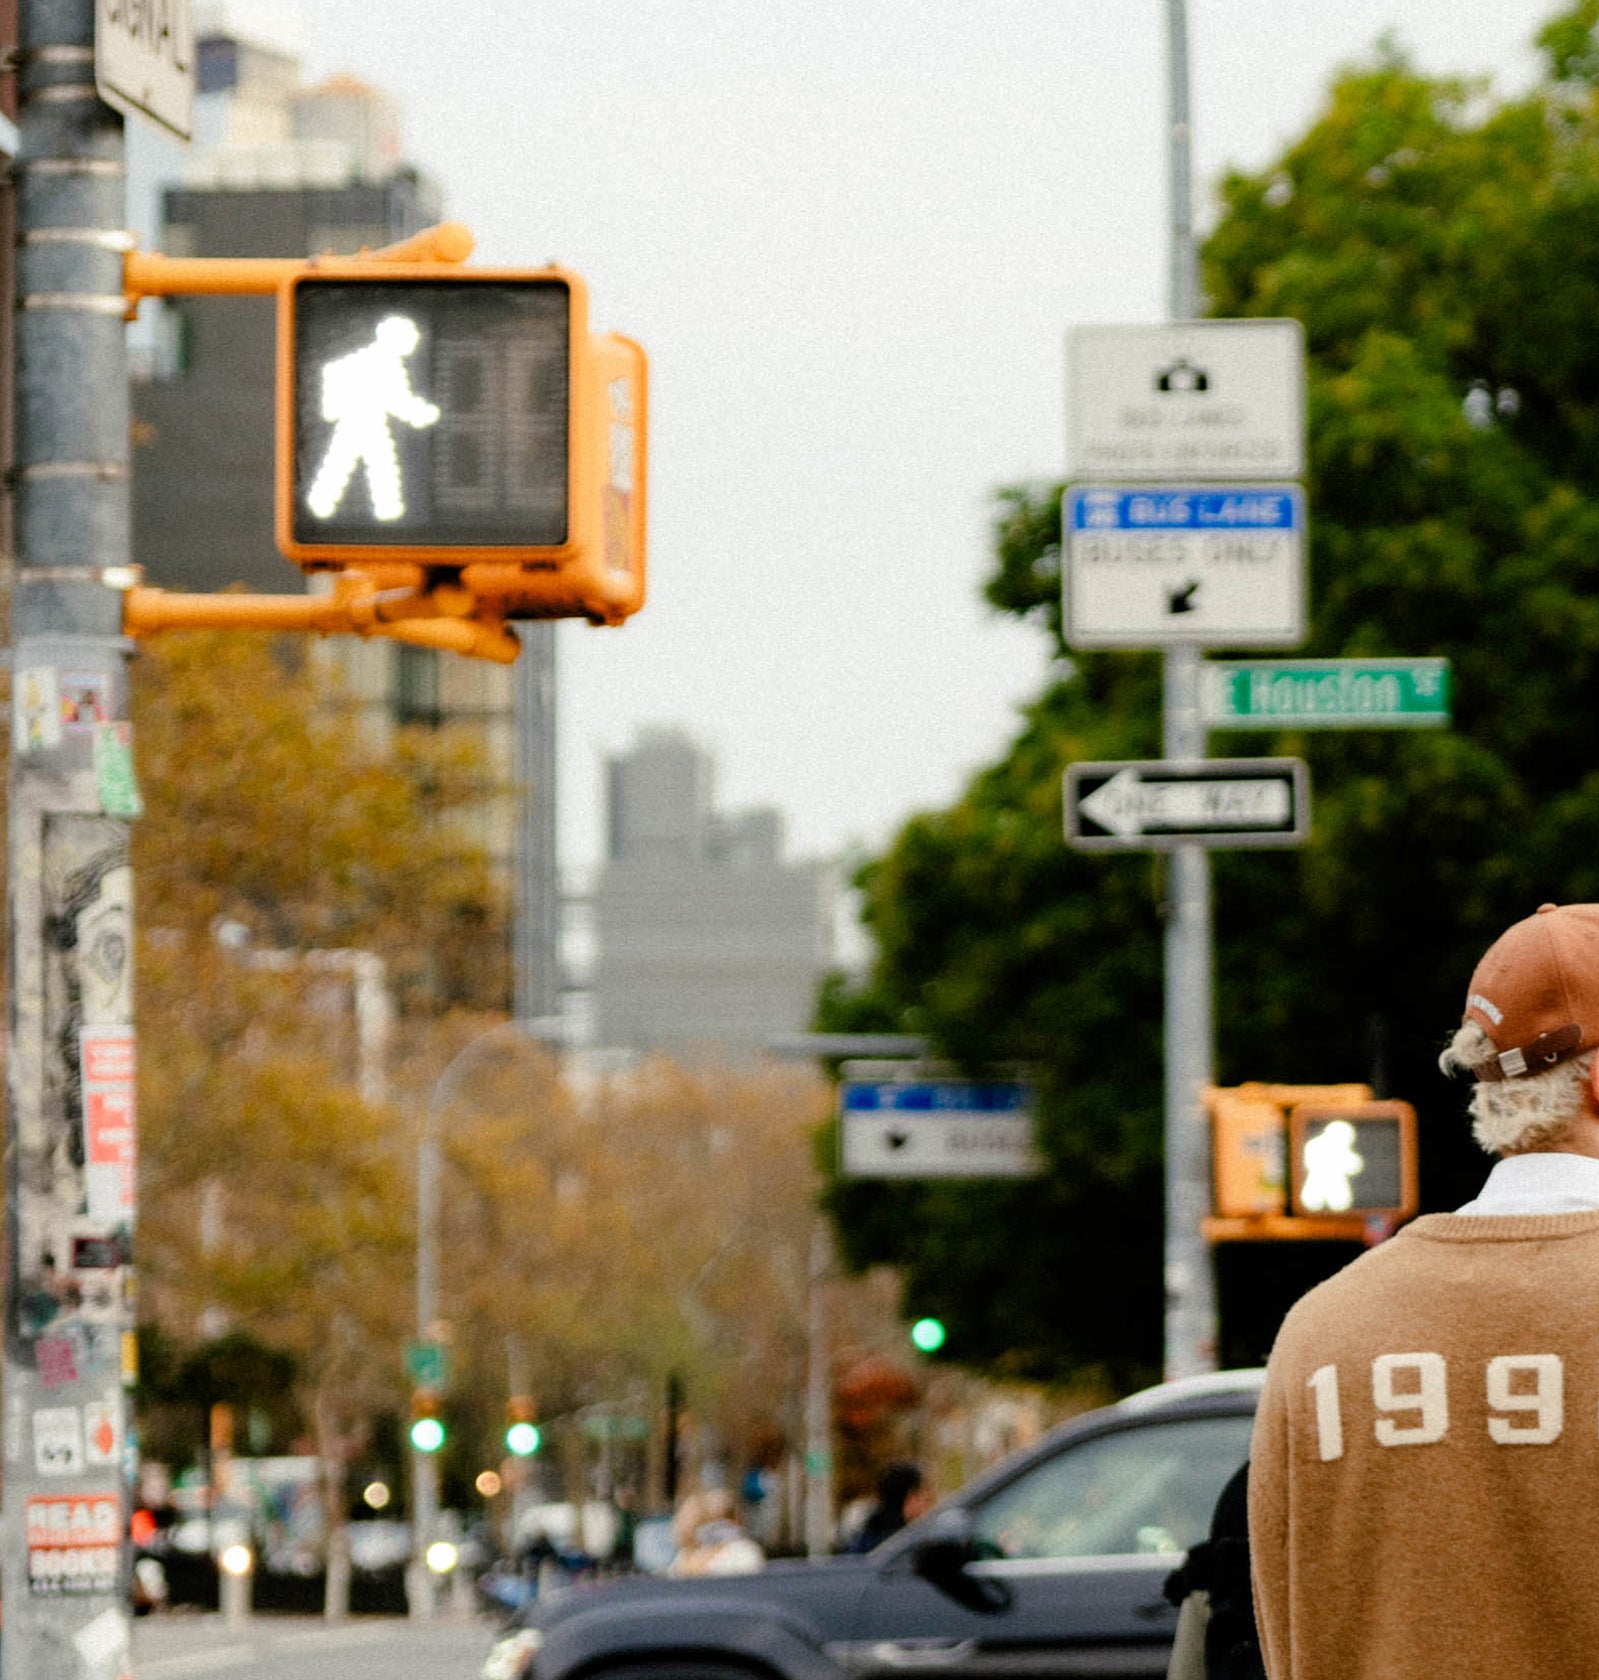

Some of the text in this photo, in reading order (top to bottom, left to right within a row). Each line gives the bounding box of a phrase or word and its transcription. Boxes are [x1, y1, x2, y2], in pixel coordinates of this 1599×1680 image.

[1129, 496, 1283, 524] BUS LANE
[1250, 667, 1400, 714] Houston
